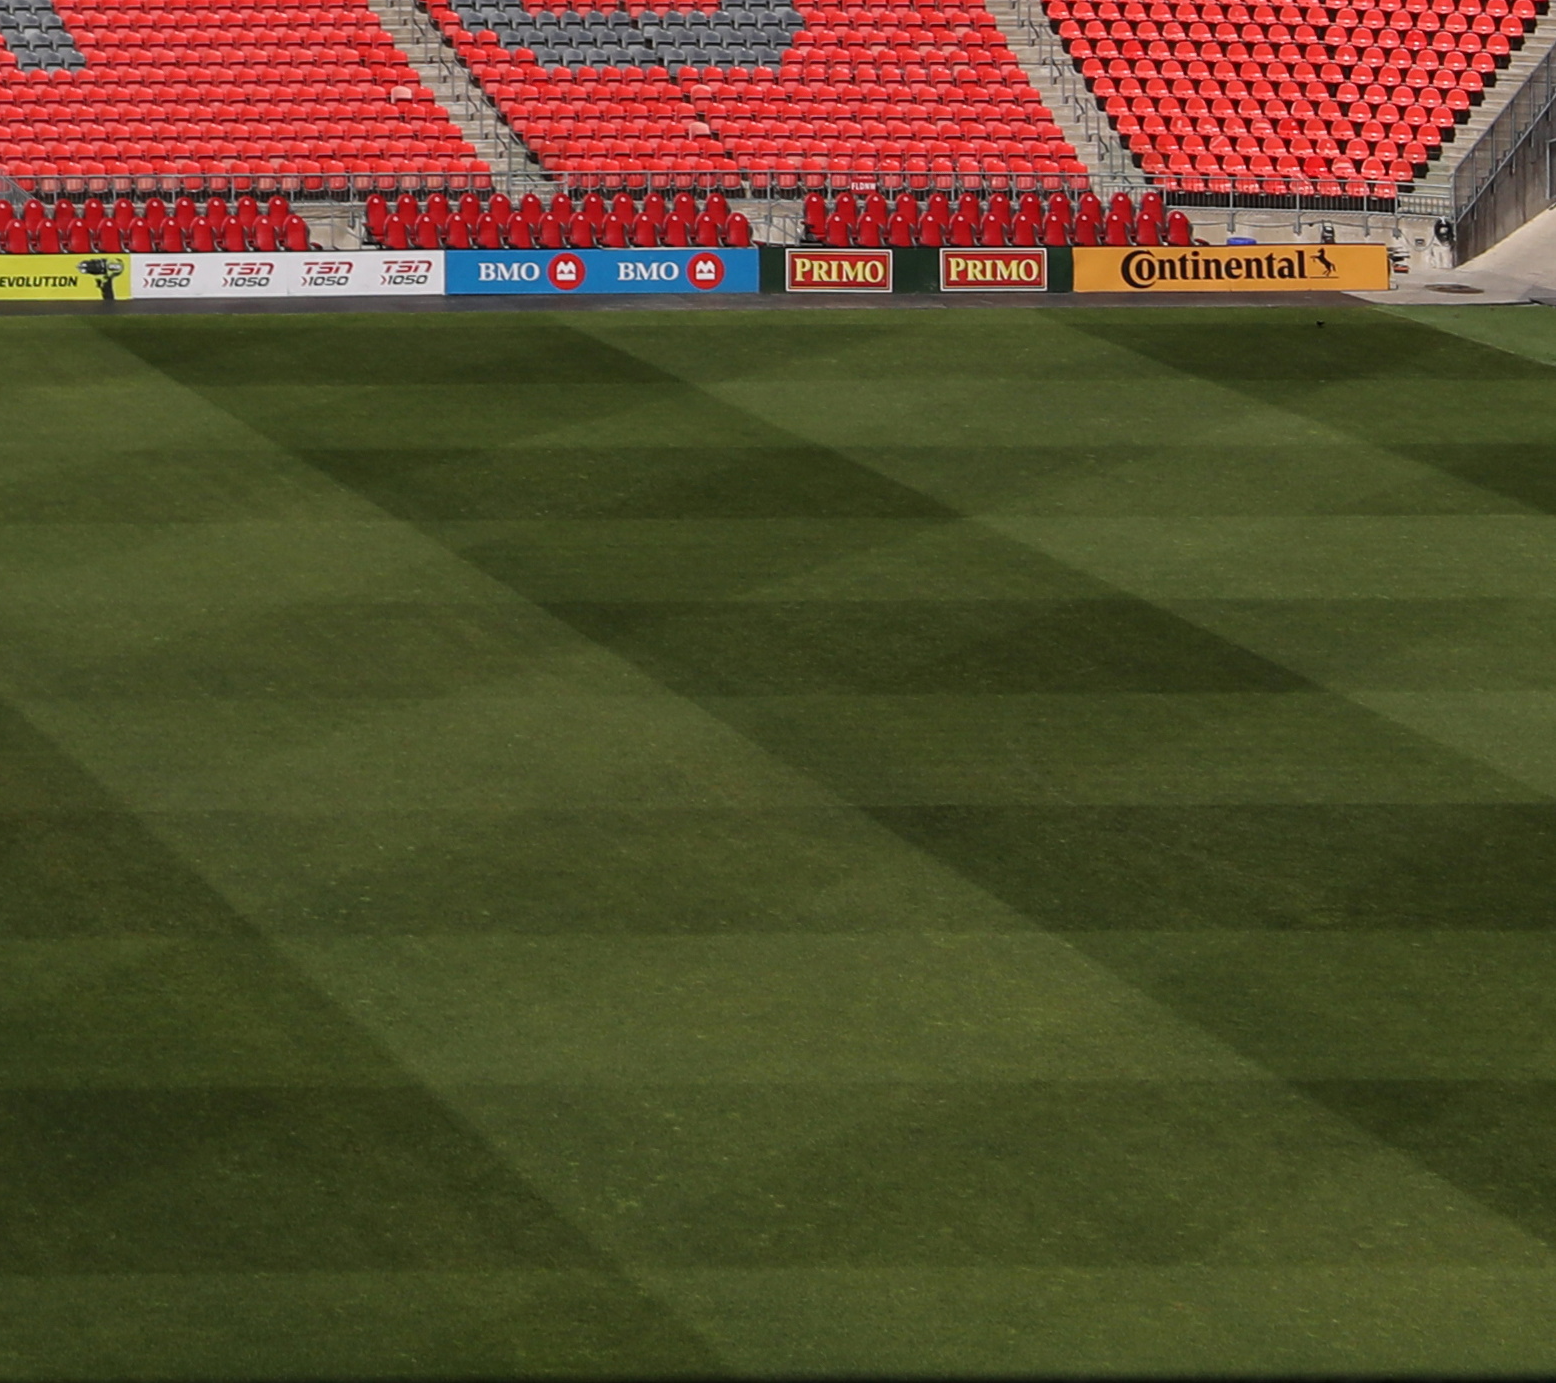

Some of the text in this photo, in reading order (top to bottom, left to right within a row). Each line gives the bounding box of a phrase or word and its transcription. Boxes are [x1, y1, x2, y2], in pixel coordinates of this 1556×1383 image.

[145, 263, 195, 275] TSN
[224, 262, 274, 275] TSN
[303, 261, 354, 274] TSN
[382, 260, 433, 273] TSN
[478, 262, 540, 282] BMO
[617, 261, 679, 281] BMO
[794, 257, 885, 283] PRIMO
[948, 257, 1039, 282] PRIMO
[1120, 249, 1309, 289] Continental
[150, 277, 190, 288] 1050
[229, 276, 270, 287] 1050
[308, 275, 349, 287] 1050
[388, 274, 428, 286] 1050
